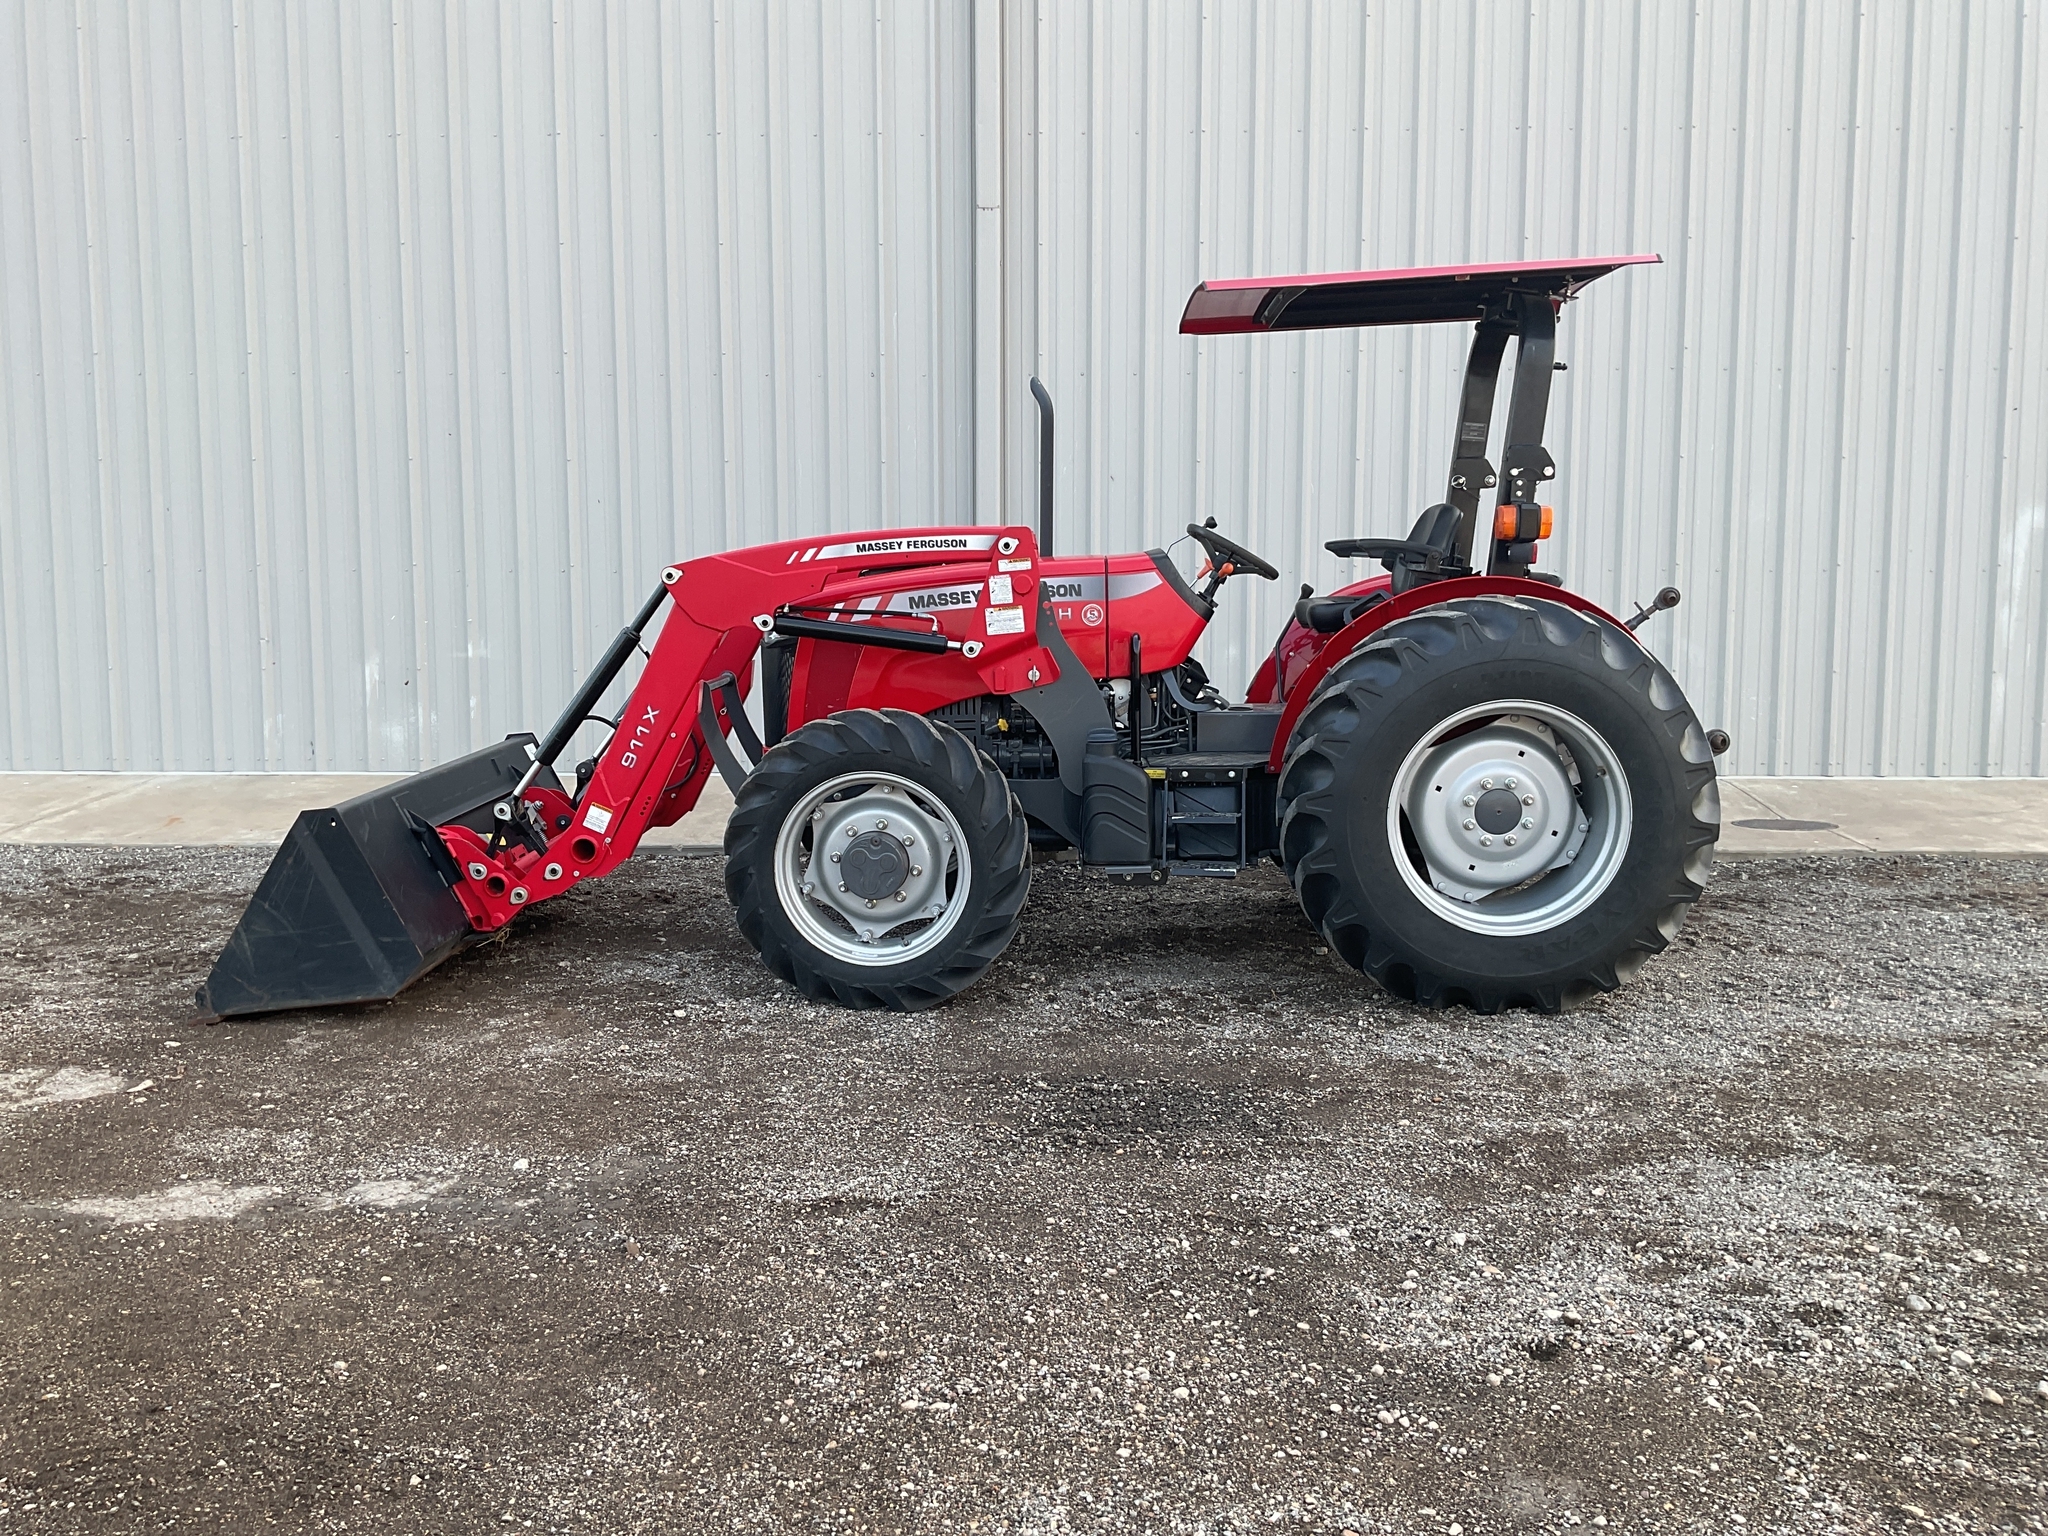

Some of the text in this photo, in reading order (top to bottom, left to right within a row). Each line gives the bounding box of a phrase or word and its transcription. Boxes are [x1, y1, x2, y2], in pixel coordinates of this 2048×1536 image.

[856, 539, 967, 553] MASSEY FERGUSON
[908, 590, 982, 610] MASSEY
[621, 704, 660, 768] 911X
